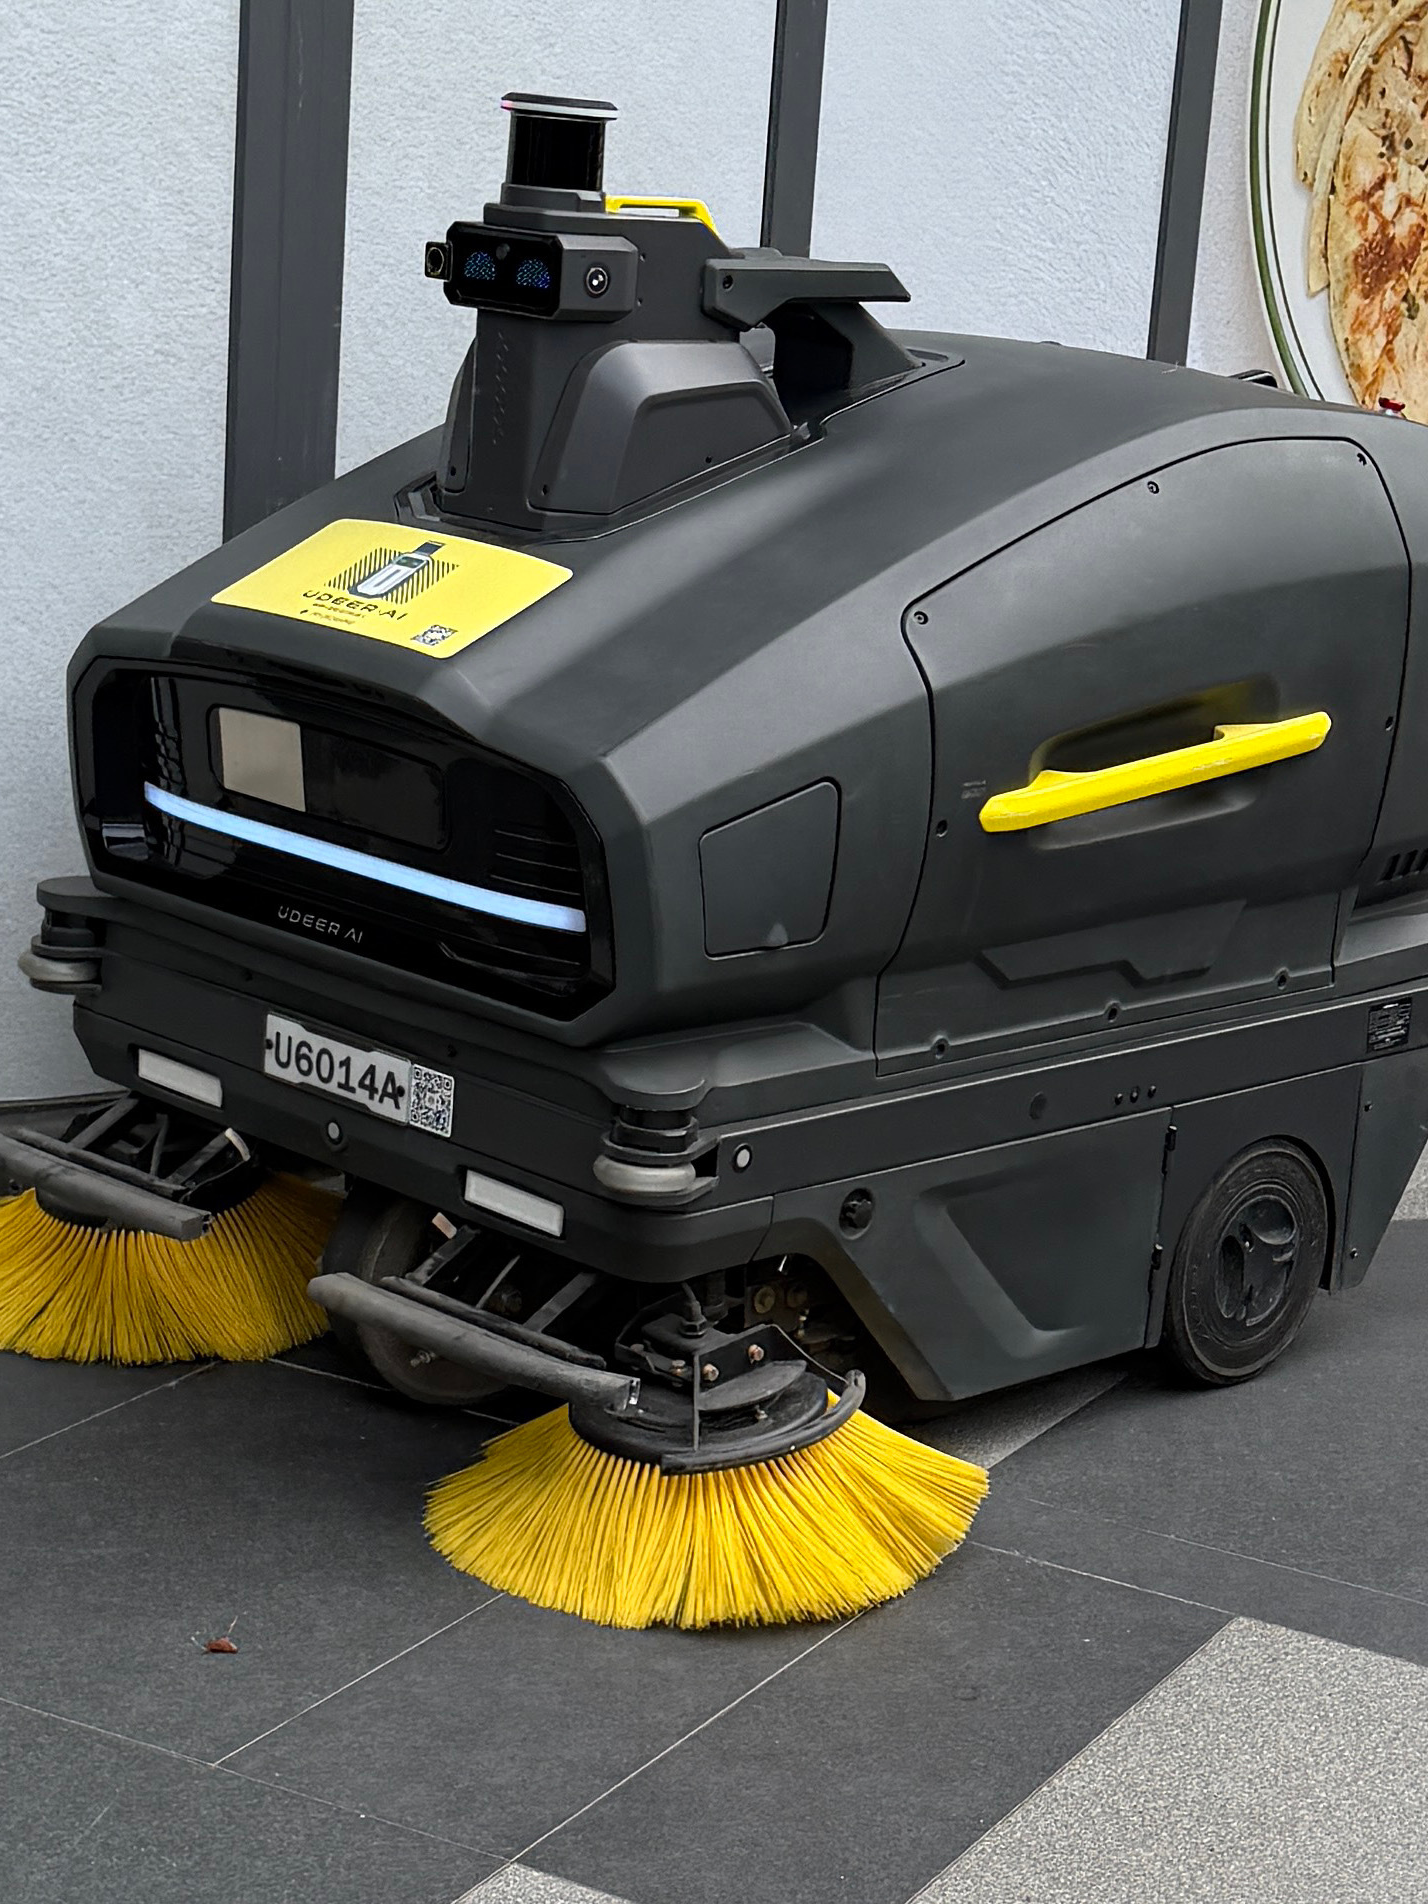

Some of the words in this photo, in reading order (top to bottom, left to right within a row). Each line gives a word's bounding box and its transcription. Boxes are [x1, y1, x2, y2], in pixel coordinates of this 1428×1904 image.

[277, 905, 340, 935] UDEER
[344, 927, 363, 944] AI
[274, 1031, 402, 1110] U6014A
